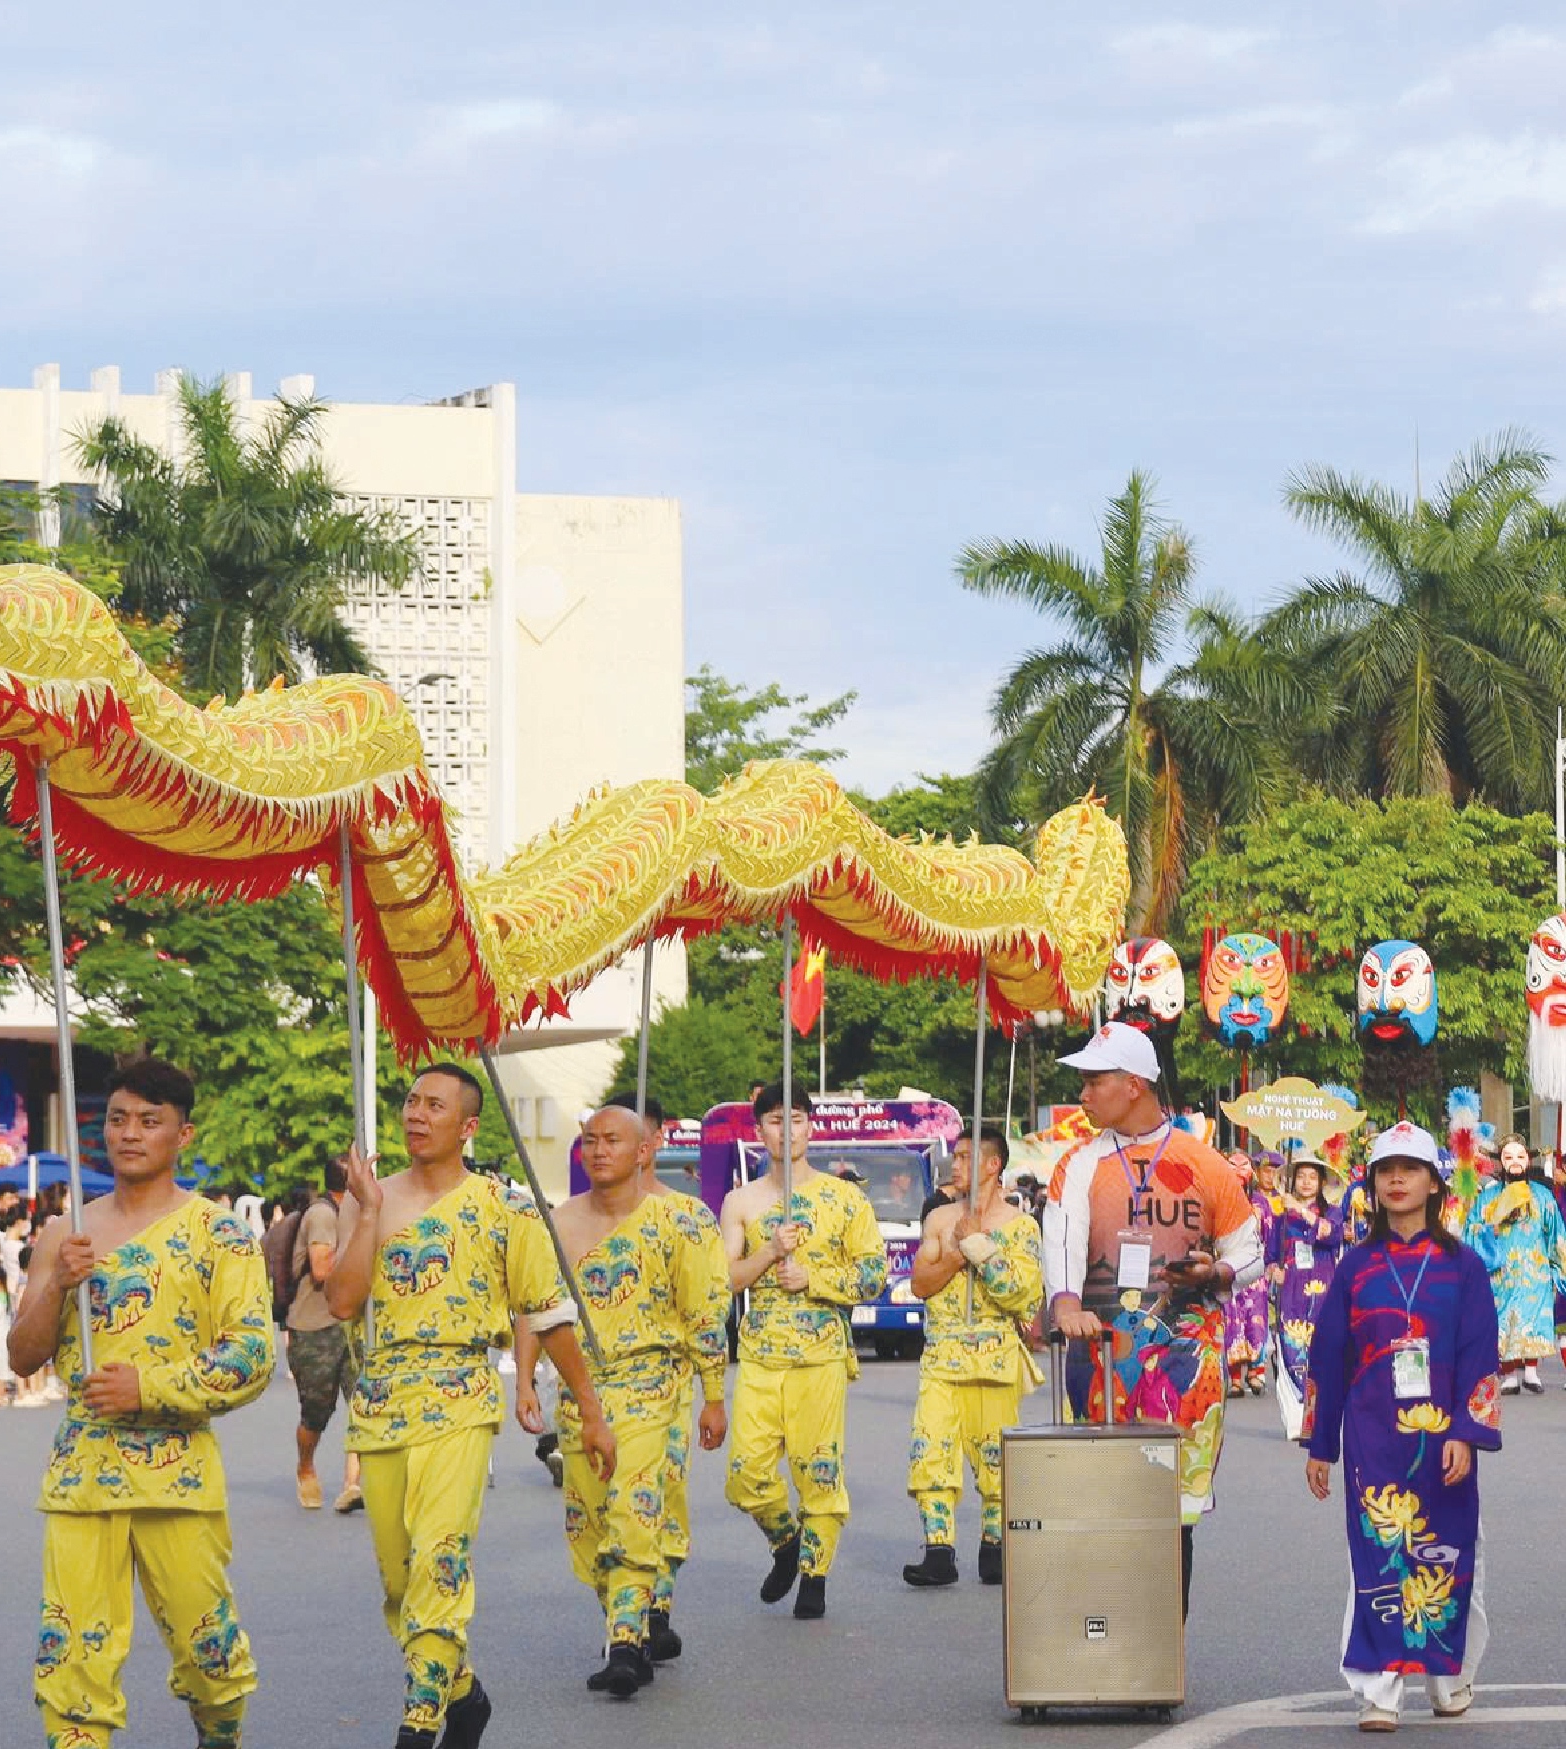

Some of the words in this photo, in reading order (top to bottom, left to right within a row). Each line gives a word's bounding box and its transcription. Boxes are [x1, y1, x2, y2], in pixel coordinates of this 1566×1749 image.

[865, 1119, 898, 1130] 2024
[1132, 1157, 1153, 1192] I
[1128, 1197, 1201, 1230] HUE
